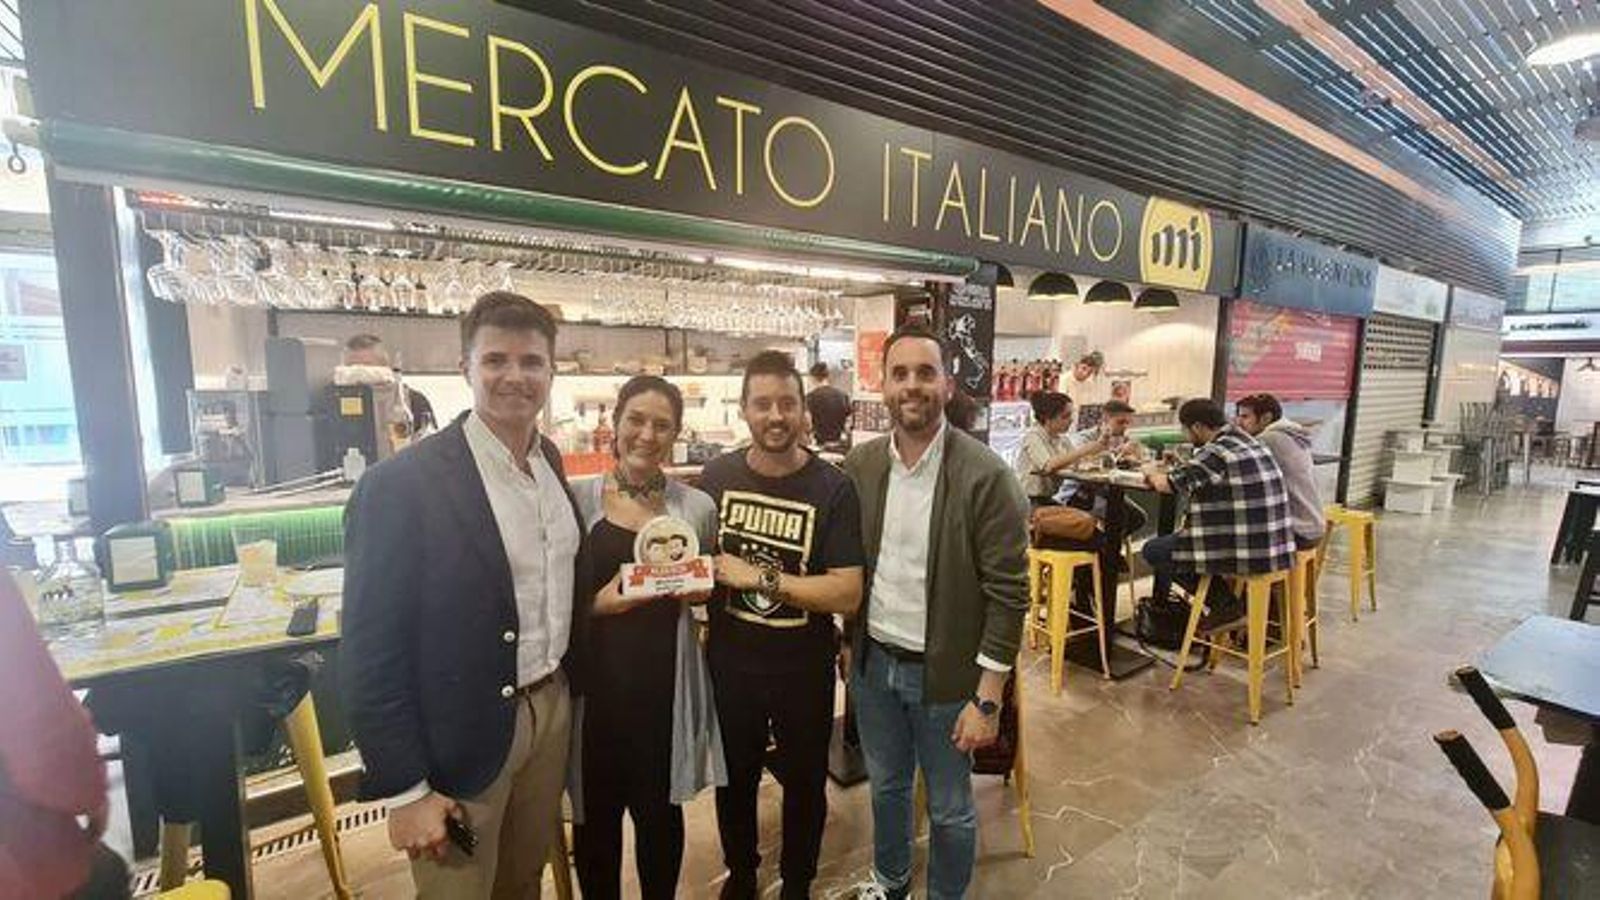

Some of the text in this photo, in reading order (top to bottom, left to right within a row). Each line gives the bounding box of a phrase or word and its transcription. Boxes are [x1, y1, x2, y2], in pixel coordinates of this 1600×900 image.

[244, 0, 1122, 262] MERCATO ITALIANO
[729, 504, 803, 539] PUMA
